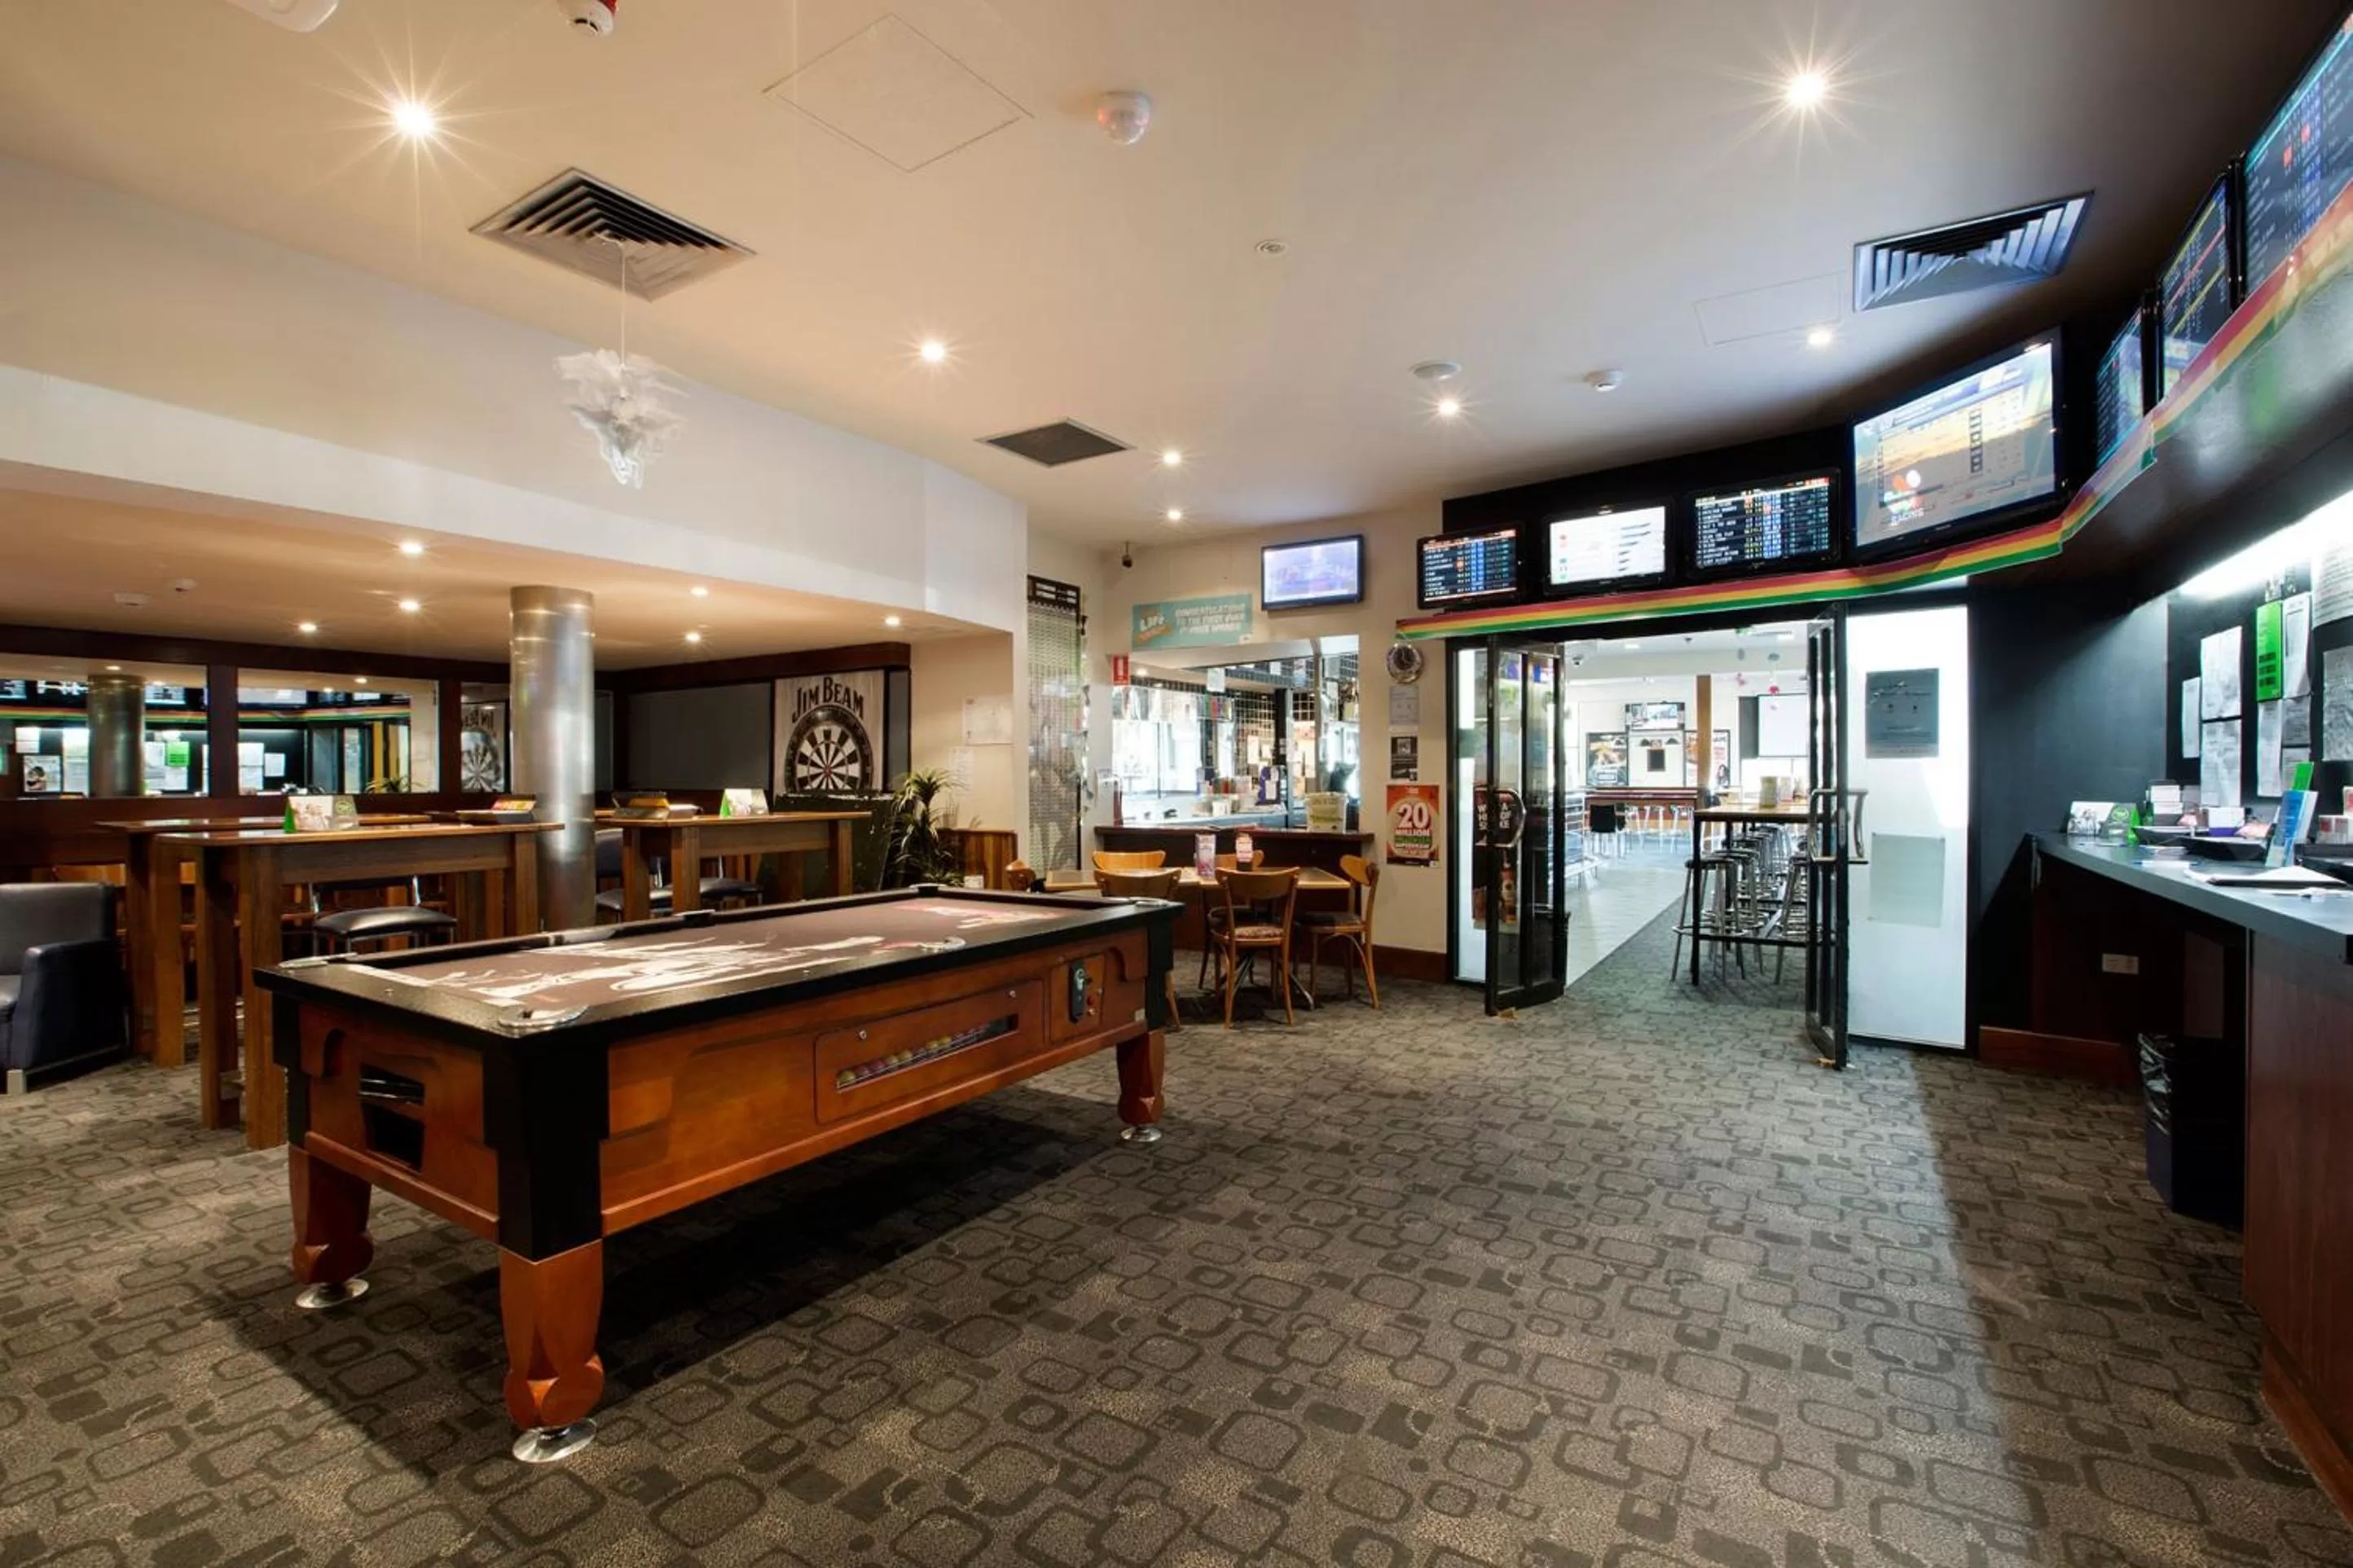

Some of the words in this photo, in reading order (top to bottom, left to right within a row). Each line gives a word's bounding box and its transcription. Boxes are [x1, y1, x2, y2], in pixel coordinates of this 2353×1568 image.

[792, 685, 819, 723] JIM
[823, 677, 864, 720] BEAM
[1398, 802, 1430, 829] 20
